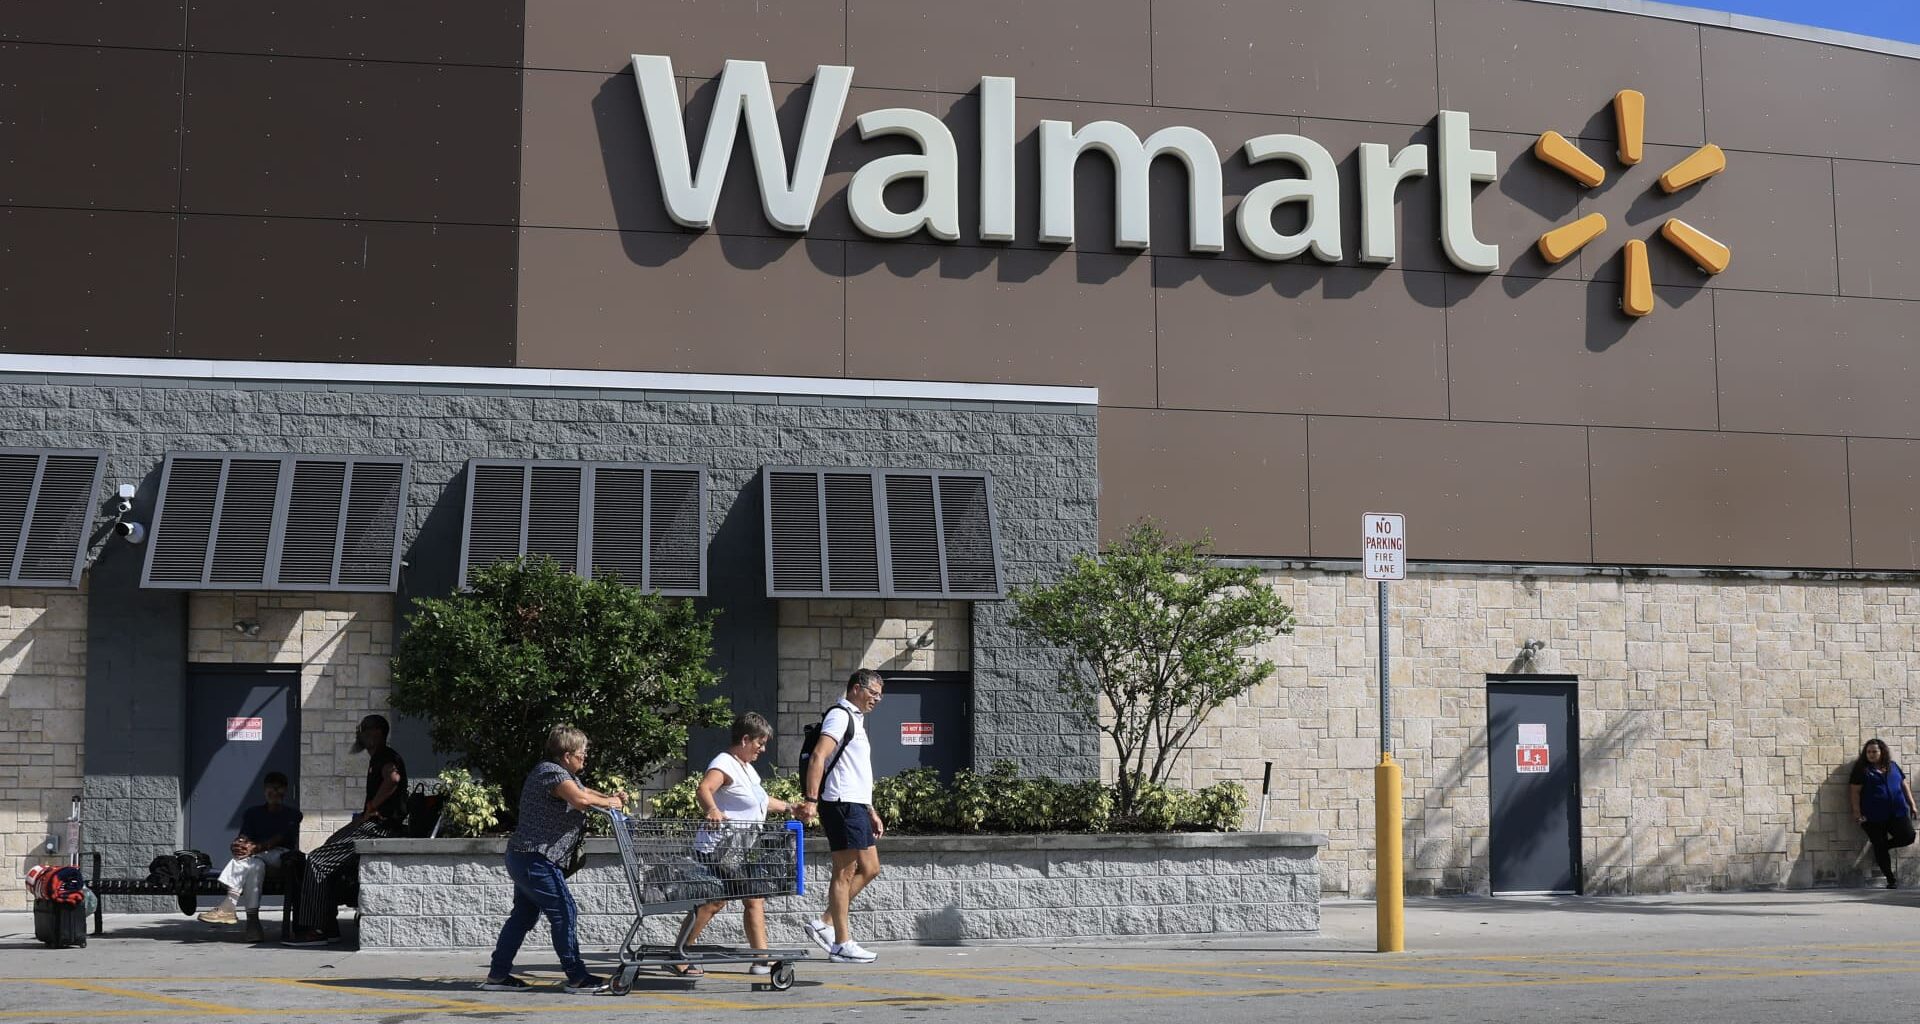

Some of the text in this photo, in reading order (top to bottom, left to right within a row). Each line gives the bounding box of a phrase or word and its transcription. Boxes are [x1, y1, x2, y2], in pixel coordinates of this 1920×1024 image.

[631, 53, 1499, 273] Walmart
[1375, 521, 1392, 534] NO
[1366, 536, 1402, 550] PARKING
[1375, 552, 1394, 562] FIRE
[1373, 564, 1395, 574] LANE
